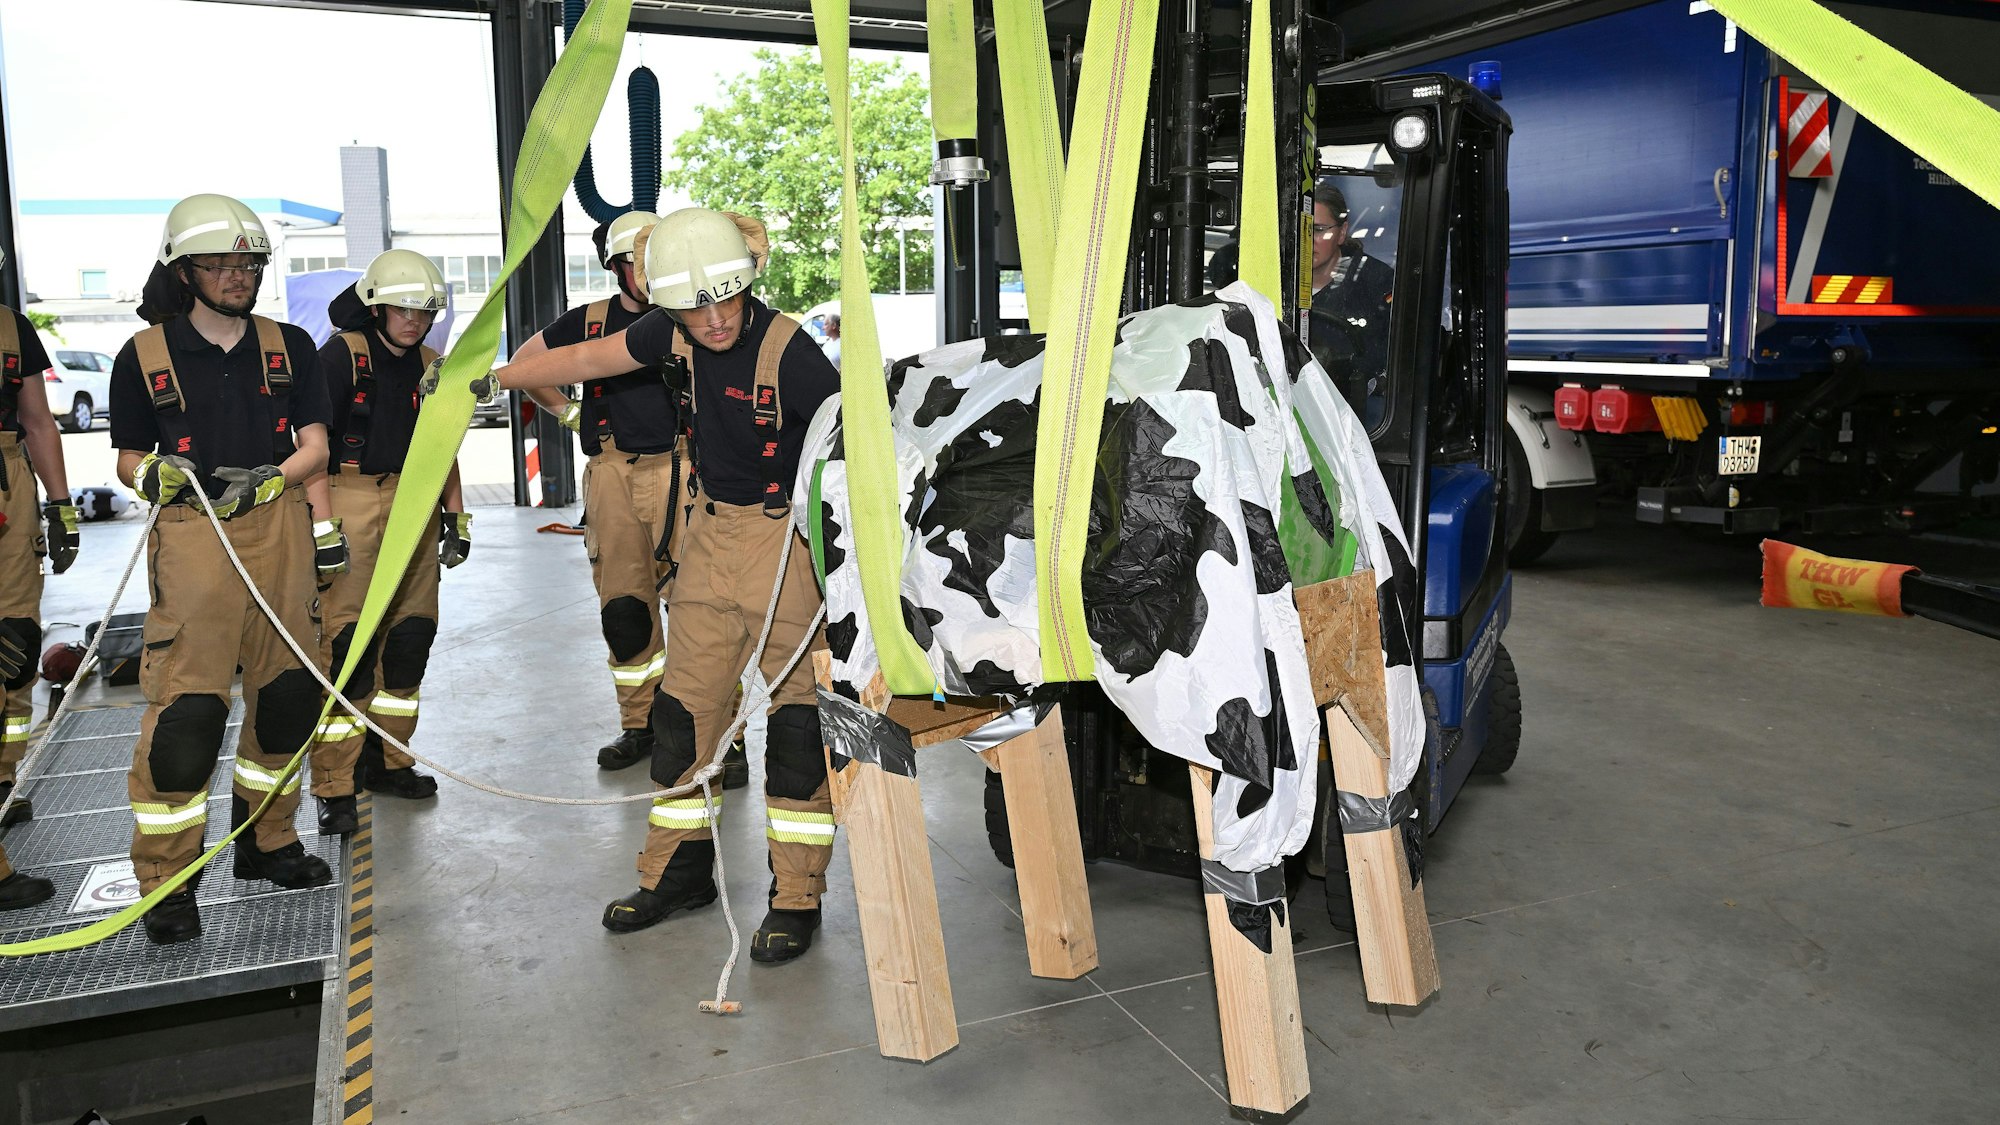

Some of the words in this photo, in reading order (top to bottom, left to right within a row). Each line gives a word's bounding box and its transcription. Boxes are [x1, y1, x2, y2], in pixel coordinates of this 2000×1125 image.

[1302, 83, 1316, 195] Yale
[734, 276, 742, 289] 5
[1731, 439, 1751, 454] THW
[1723, 456, 1755, 473] 93759
[1801, 558, 1869, 587] THW
